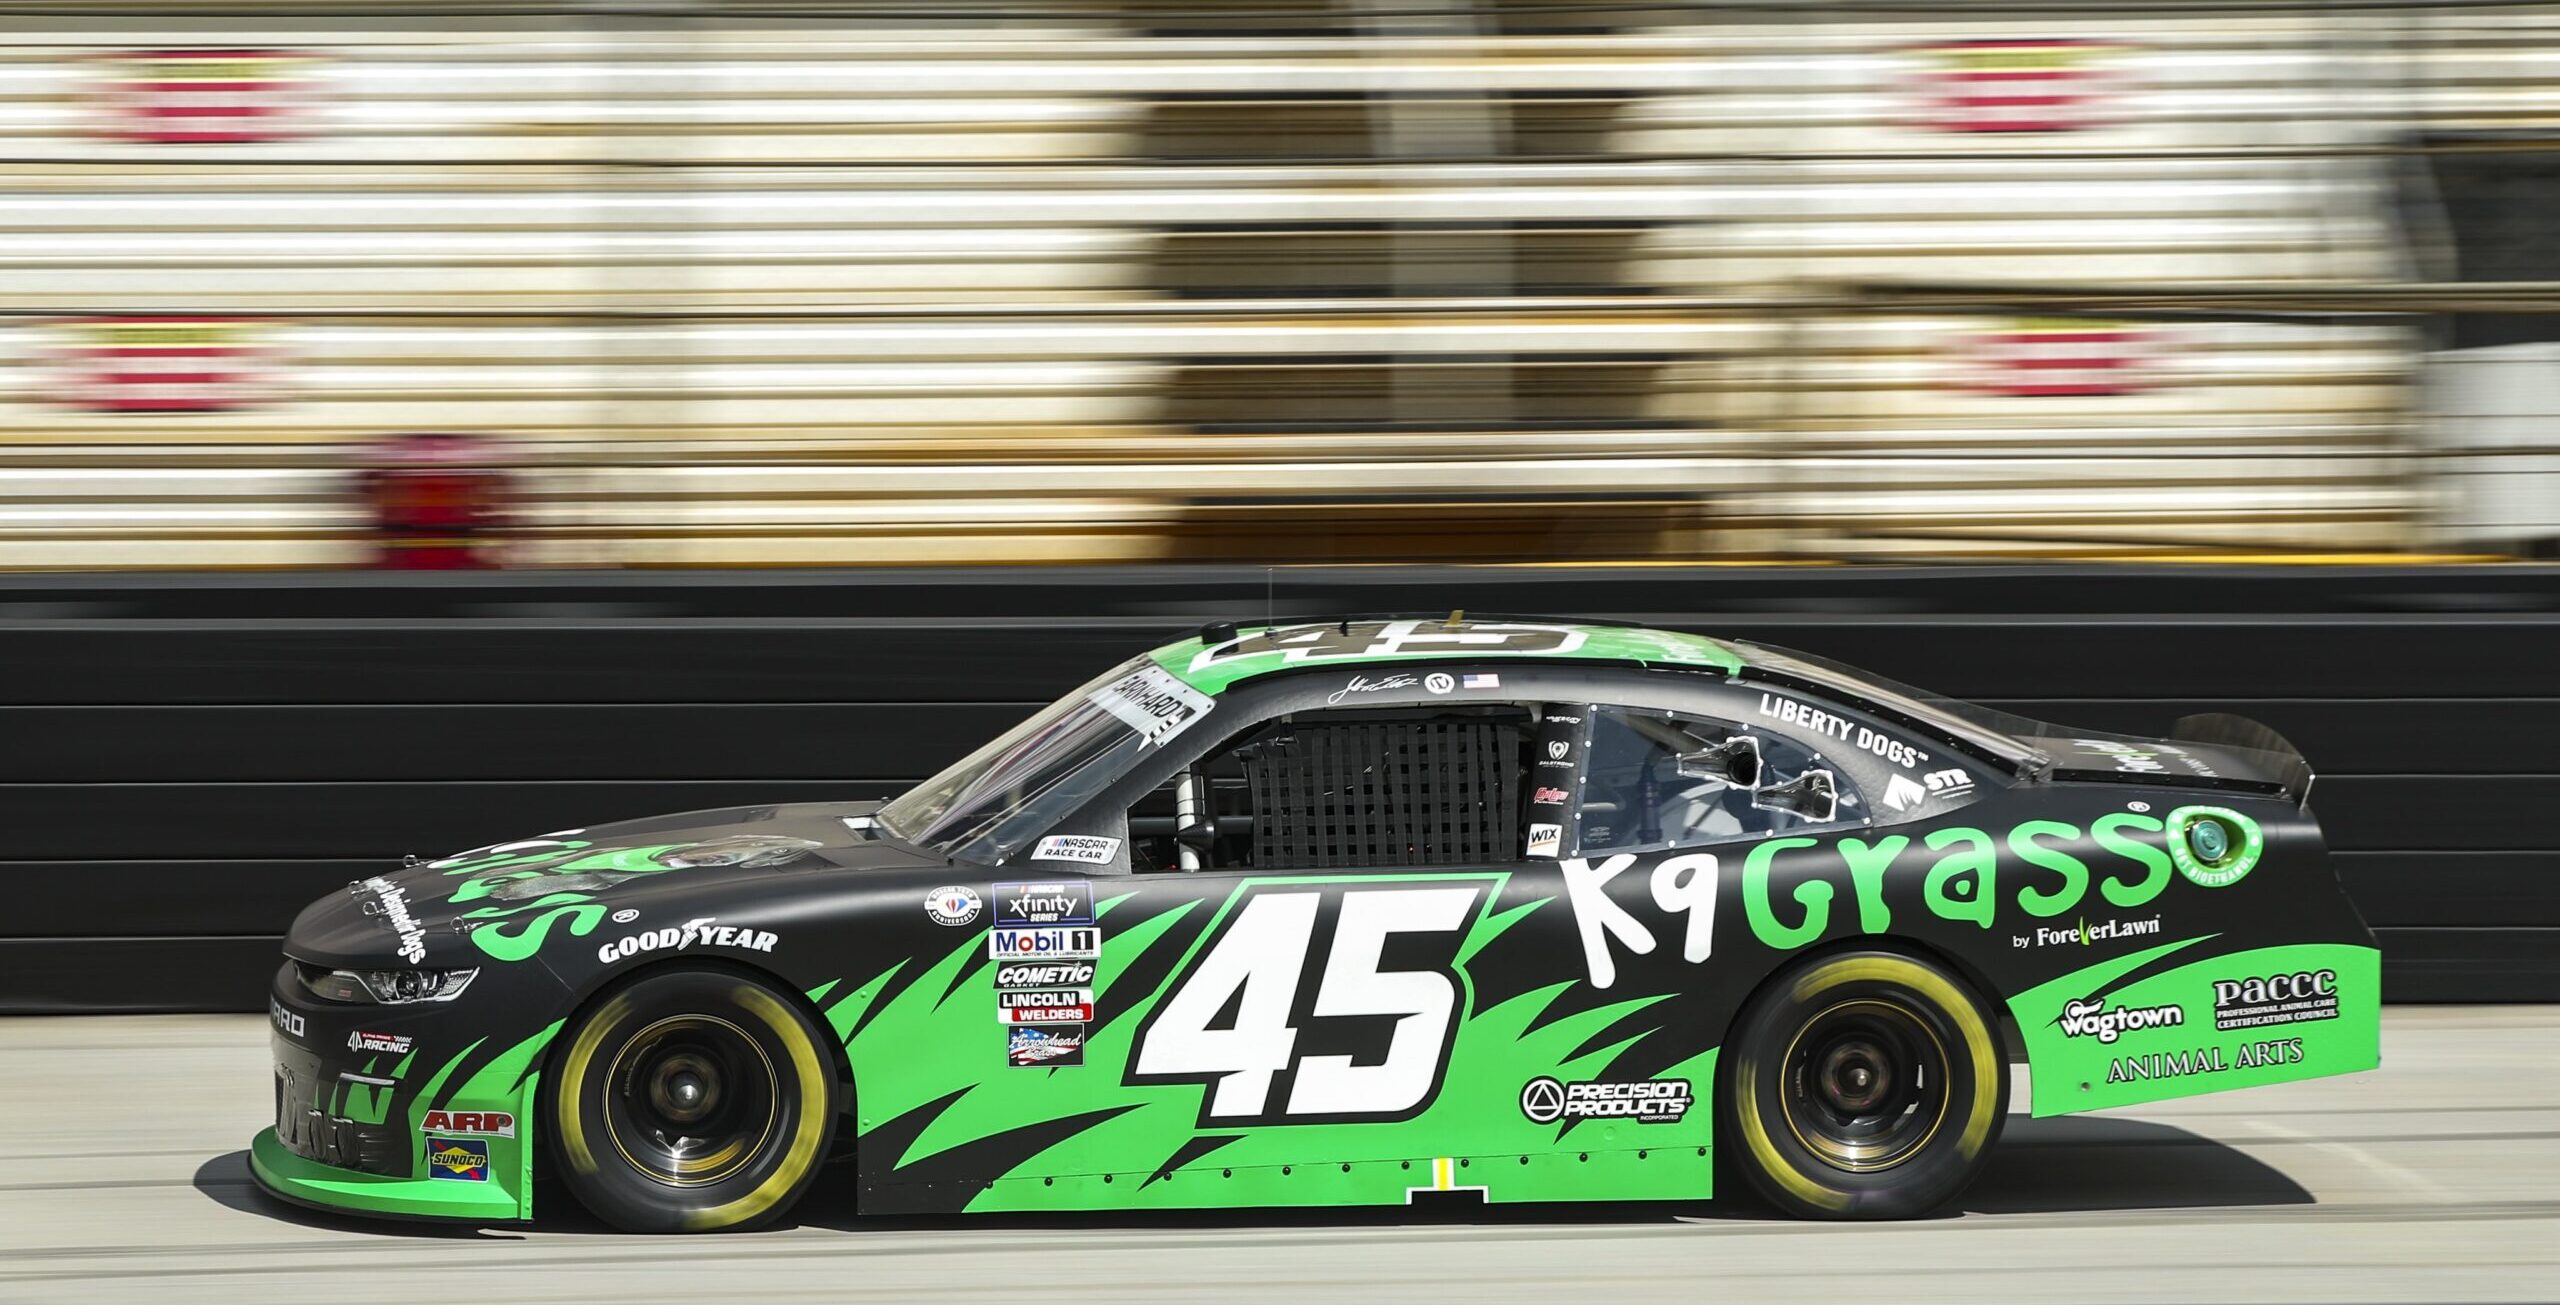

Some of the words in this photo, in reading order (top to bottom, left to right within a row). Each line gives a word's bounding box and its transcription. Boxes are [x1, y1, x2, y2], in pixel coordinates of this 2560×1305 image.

[1759, 693, 1855, 741] LIBERTY
[1923, 768, 1971, 790] STR
[1062, 838, 1109, 850] NASCAR
[1531, 828, 1558, 843] WIX
[1045, 848, 1075, 857] RACE
[1078, 850, 1103, 860] CAR
[1741, 812, 2174, 950] Grass
[1009, 894, 1078, 918] xfinity
[1030, 913, 1059, 922] SERIES
[397, 928, 426, 964] Dogs
[598, 917, 779, 964] GOODYEAR
[996, 931, 1063, 952] Mobil
[1072, 930, 1094, 950] 1
[2013, 935, 2030, 948] by
[997, 964, 1094, 984] COMETIC
[1002, 992, 1076, 1007] LINCOLN
[1135, 888, 1480, 1117] 45
[1019, 1009, 1084, 1020] WELDERS
[2060, 1000, 2183, 1042] wagtown
[2217, 1013, 2294, 1029] CERTIFICATION
[2293, 1008, 2338, 1021] COUNCIL
[363, 1039, 409, 1053] RACING
[2106, 1049, 2227, 1083] ANIMAL
[2235, 1039, 2304, 1069] ARTS
[1567, 1082, 1688, 1100] PRECISION
[1564, 1099, 1686, 1116] PRODUCTS
[422, 1112, 514, 1132] ARP
[433, 1153, 484, 1166] SUNOCO
